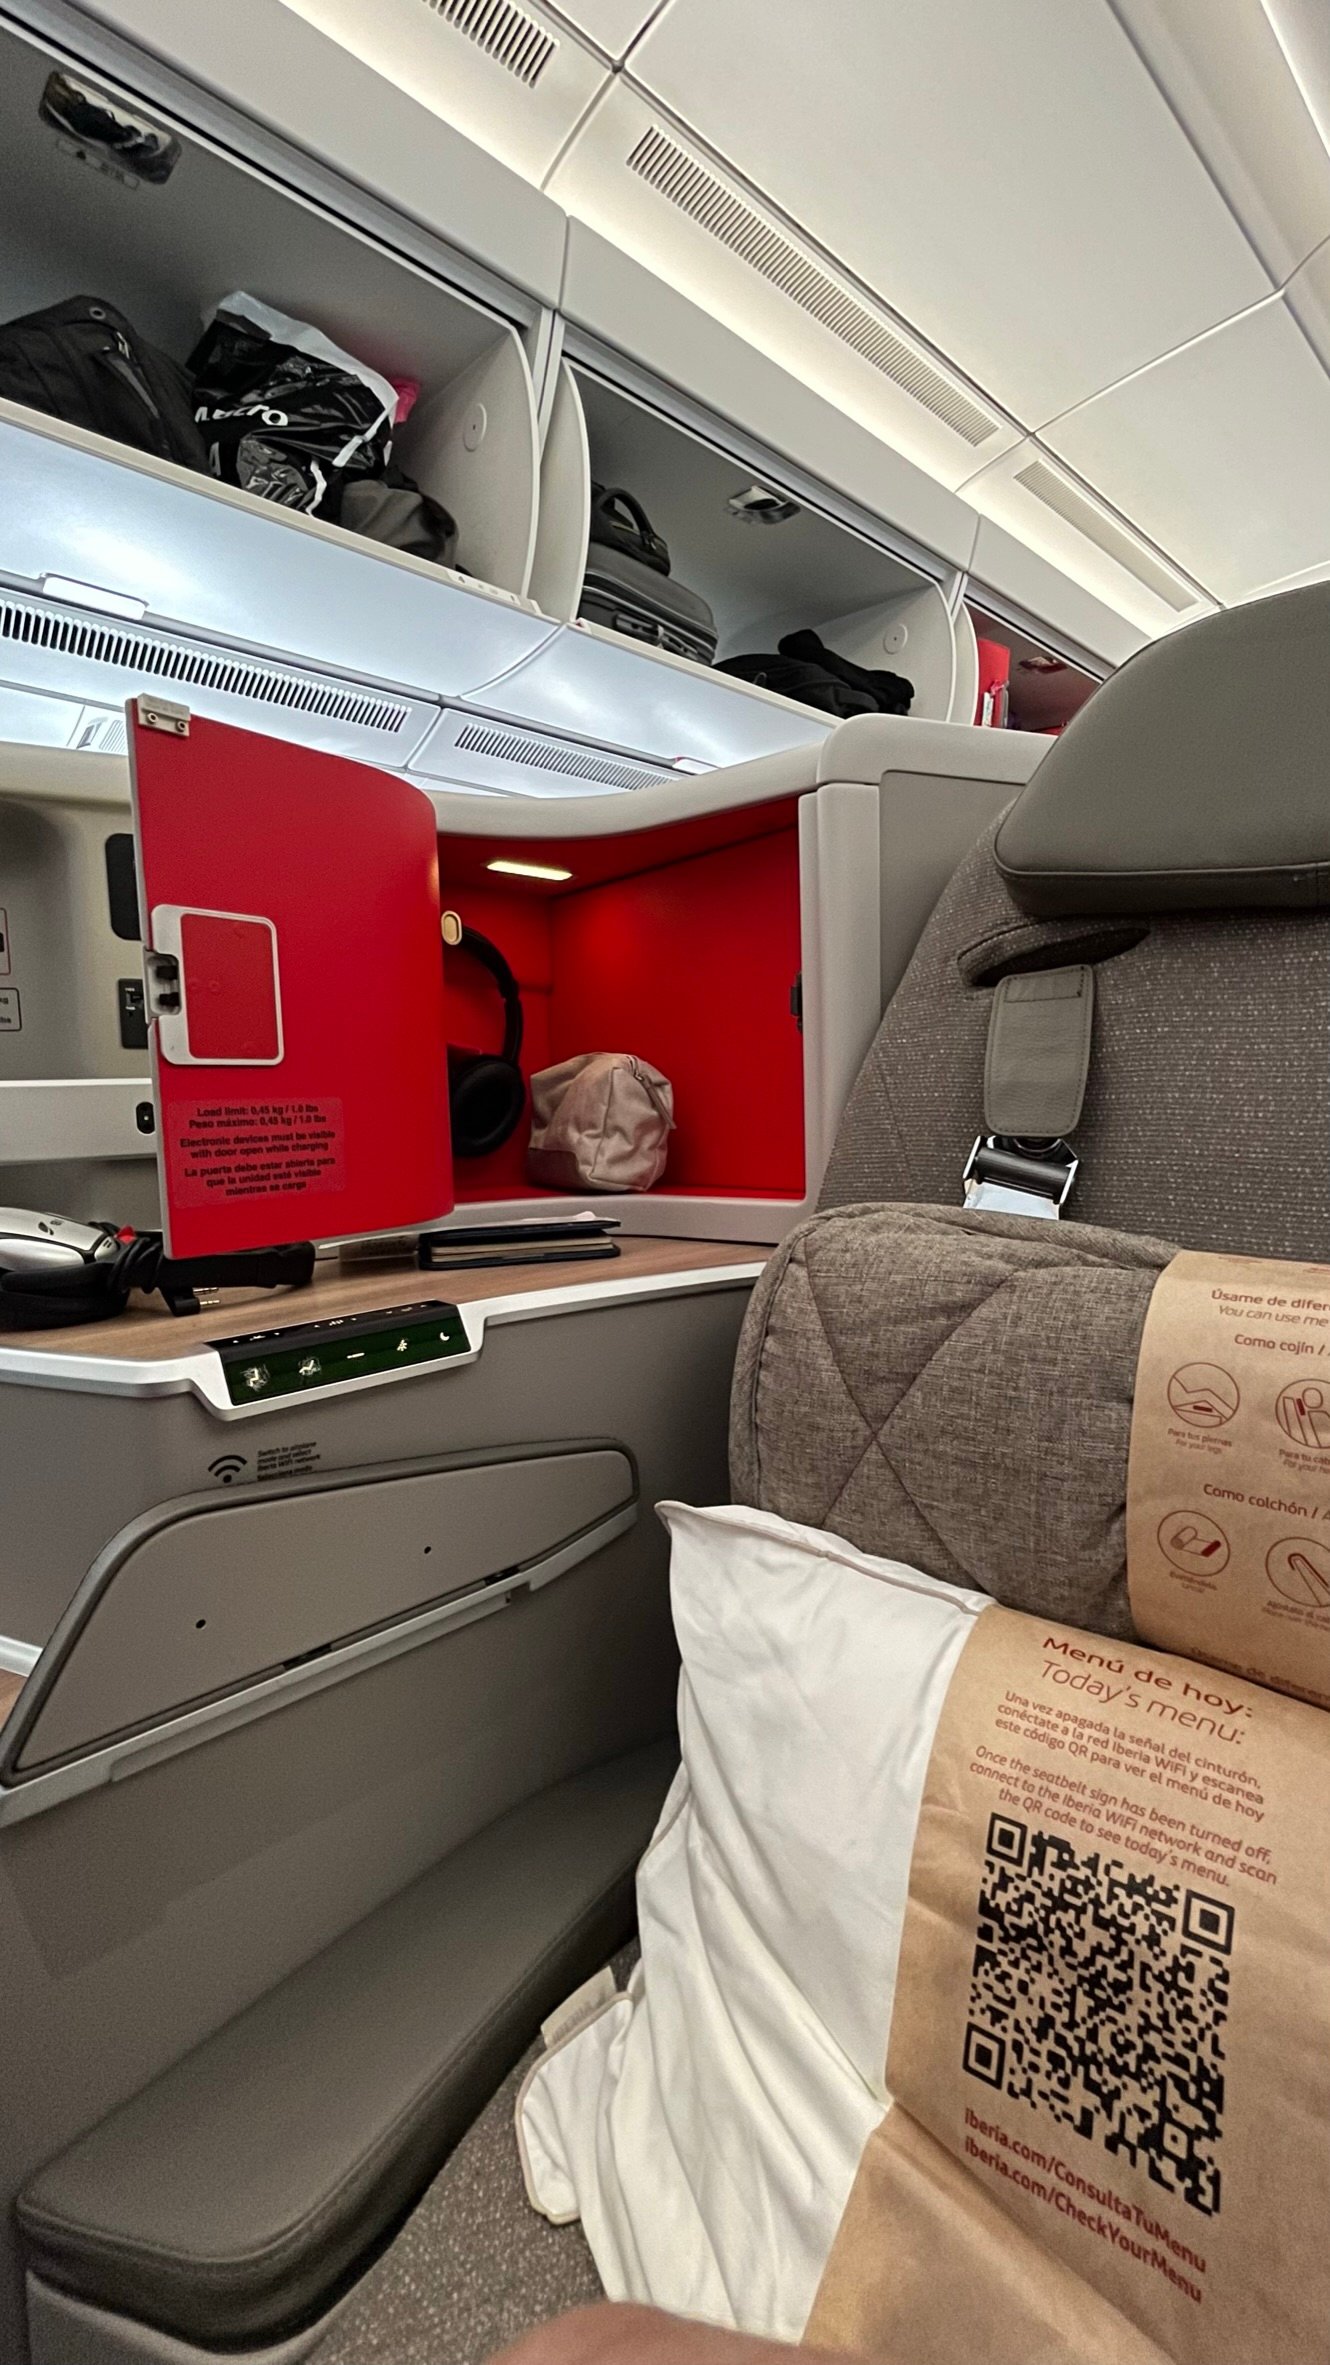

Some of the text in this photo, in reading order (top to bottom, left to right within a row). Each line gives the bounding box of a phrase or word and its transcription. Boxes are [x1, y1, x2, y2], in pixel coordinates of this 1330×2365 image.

[197, 1107, 222, 1117] Load
[224, 1107, 249, 1115] limit:
[272, 1106, 283, 1115] kg
[291, 1104, 303, 1113] 1.0
[305, 1104, 319, 1113] lbs
[189, 1119, 214, 1128] Peso
[217, 1118, 257, 1127] máximo:
[260, 1116, 278, 1126] 0,45
[281, 1116, 292, 1126] kg
[299, 1115, 312, 1124] 1.0
[180, 1130, 335, 1148] Electronic devices must be visible
[191, 1142, 328, 1158] with door open while charging
[184, 1158, 335, 1177] La puerta debe estar abierta para
[206, 1169, 321, 1188] que la unidad esté visible
[225, 1185, 267, 1196] mientras
[282, 1181, 306, 1190] carga
[1211, 1288, 1263, 1305] Úsame
[1267, 1296, 1287, 1307] de
[1219, 1305, 1329, 1327] You can use me
[1234, 1334, 1276, 1349] Como
[1279, 1341, 1314, 1355] cojín
[1317, 1344, 1325, 1355] /
[1167, 1428, 1232, 1447] Para tus piernas
[1279, 1449, 1299, 1460] Para
[1301, 1453, 1311, 1462] tu
[1203, 1483, 1244, 1503] Como
[1248, 1495, 1307, 1517] colchón
[1311, 1507, 1318, 1519] /
[1042, 1637, 1253, 1718] Menú de hoy:
[1041, 1660, 1245, 1745] Today's menu:
[1005, 1690, 1029, 1708] Una
[1032, 1702, 1053, 1715] vez
[1055, 1710, 1110, 1735] apagada
[1113, 1727, 1126, 1740] la
[1128, 1735, 1165, 1754] señal
[1169, 1747, 1191, 1764] del
[997, 1704, 1264, 1805] conéctate a la red Iberia WiFi y escanea
[995, 1719, 1265, 1823] este código QR para ver el menú de hoy
[976, 1745, 1272, 1865] Once the seatbelt sign has been turned off,
[970, 1762, 1277, 1885] connect to the Iberia WiFi network and scan
[999, 1788, 1230, 1887] the QR code to see today's menu.
